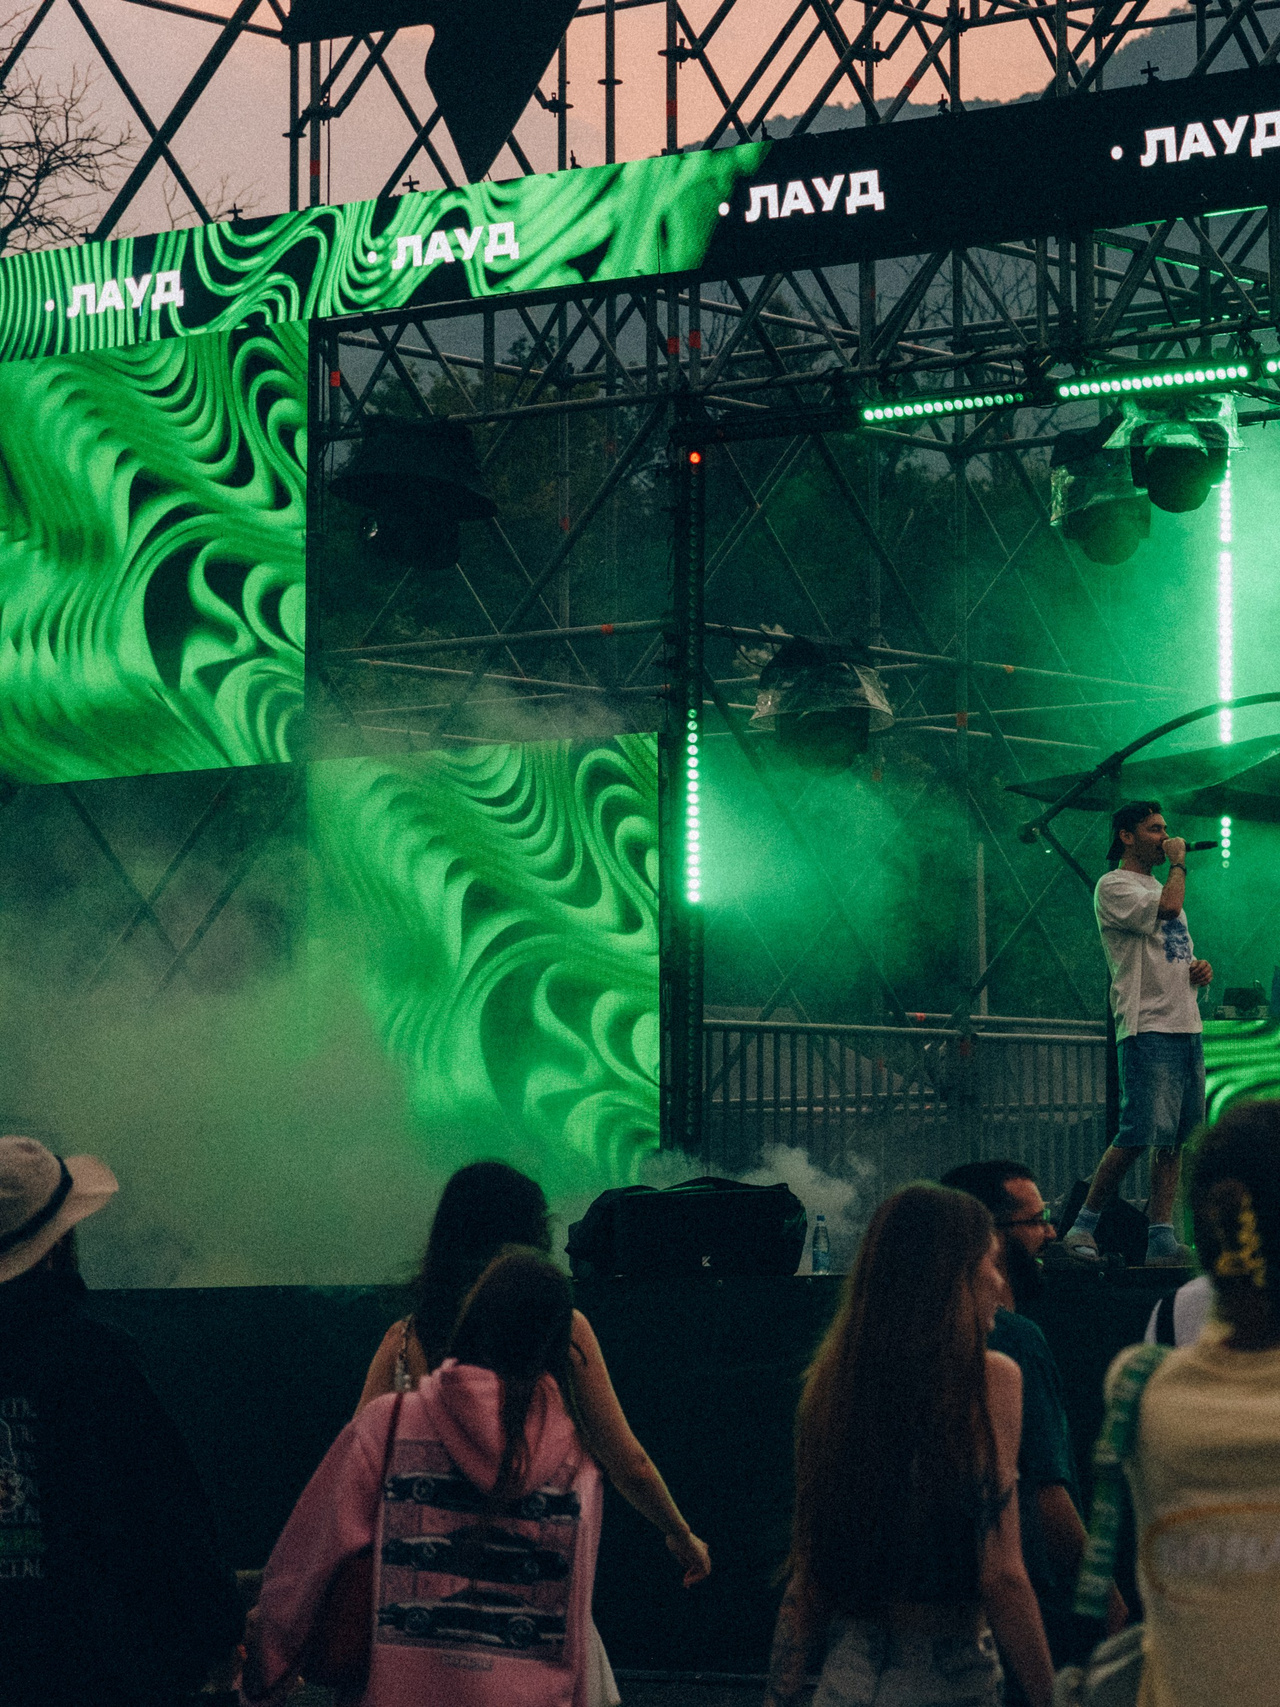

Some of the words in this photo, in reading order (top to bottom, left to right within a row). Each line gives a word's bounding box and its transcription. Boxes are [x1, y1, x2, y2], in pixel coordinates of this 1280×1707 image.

[745, 169, 885, 223] ЛАУД
[390, 220, 521, 272] ЛАУД
[66, 269, 185, 320] ЛАУД
